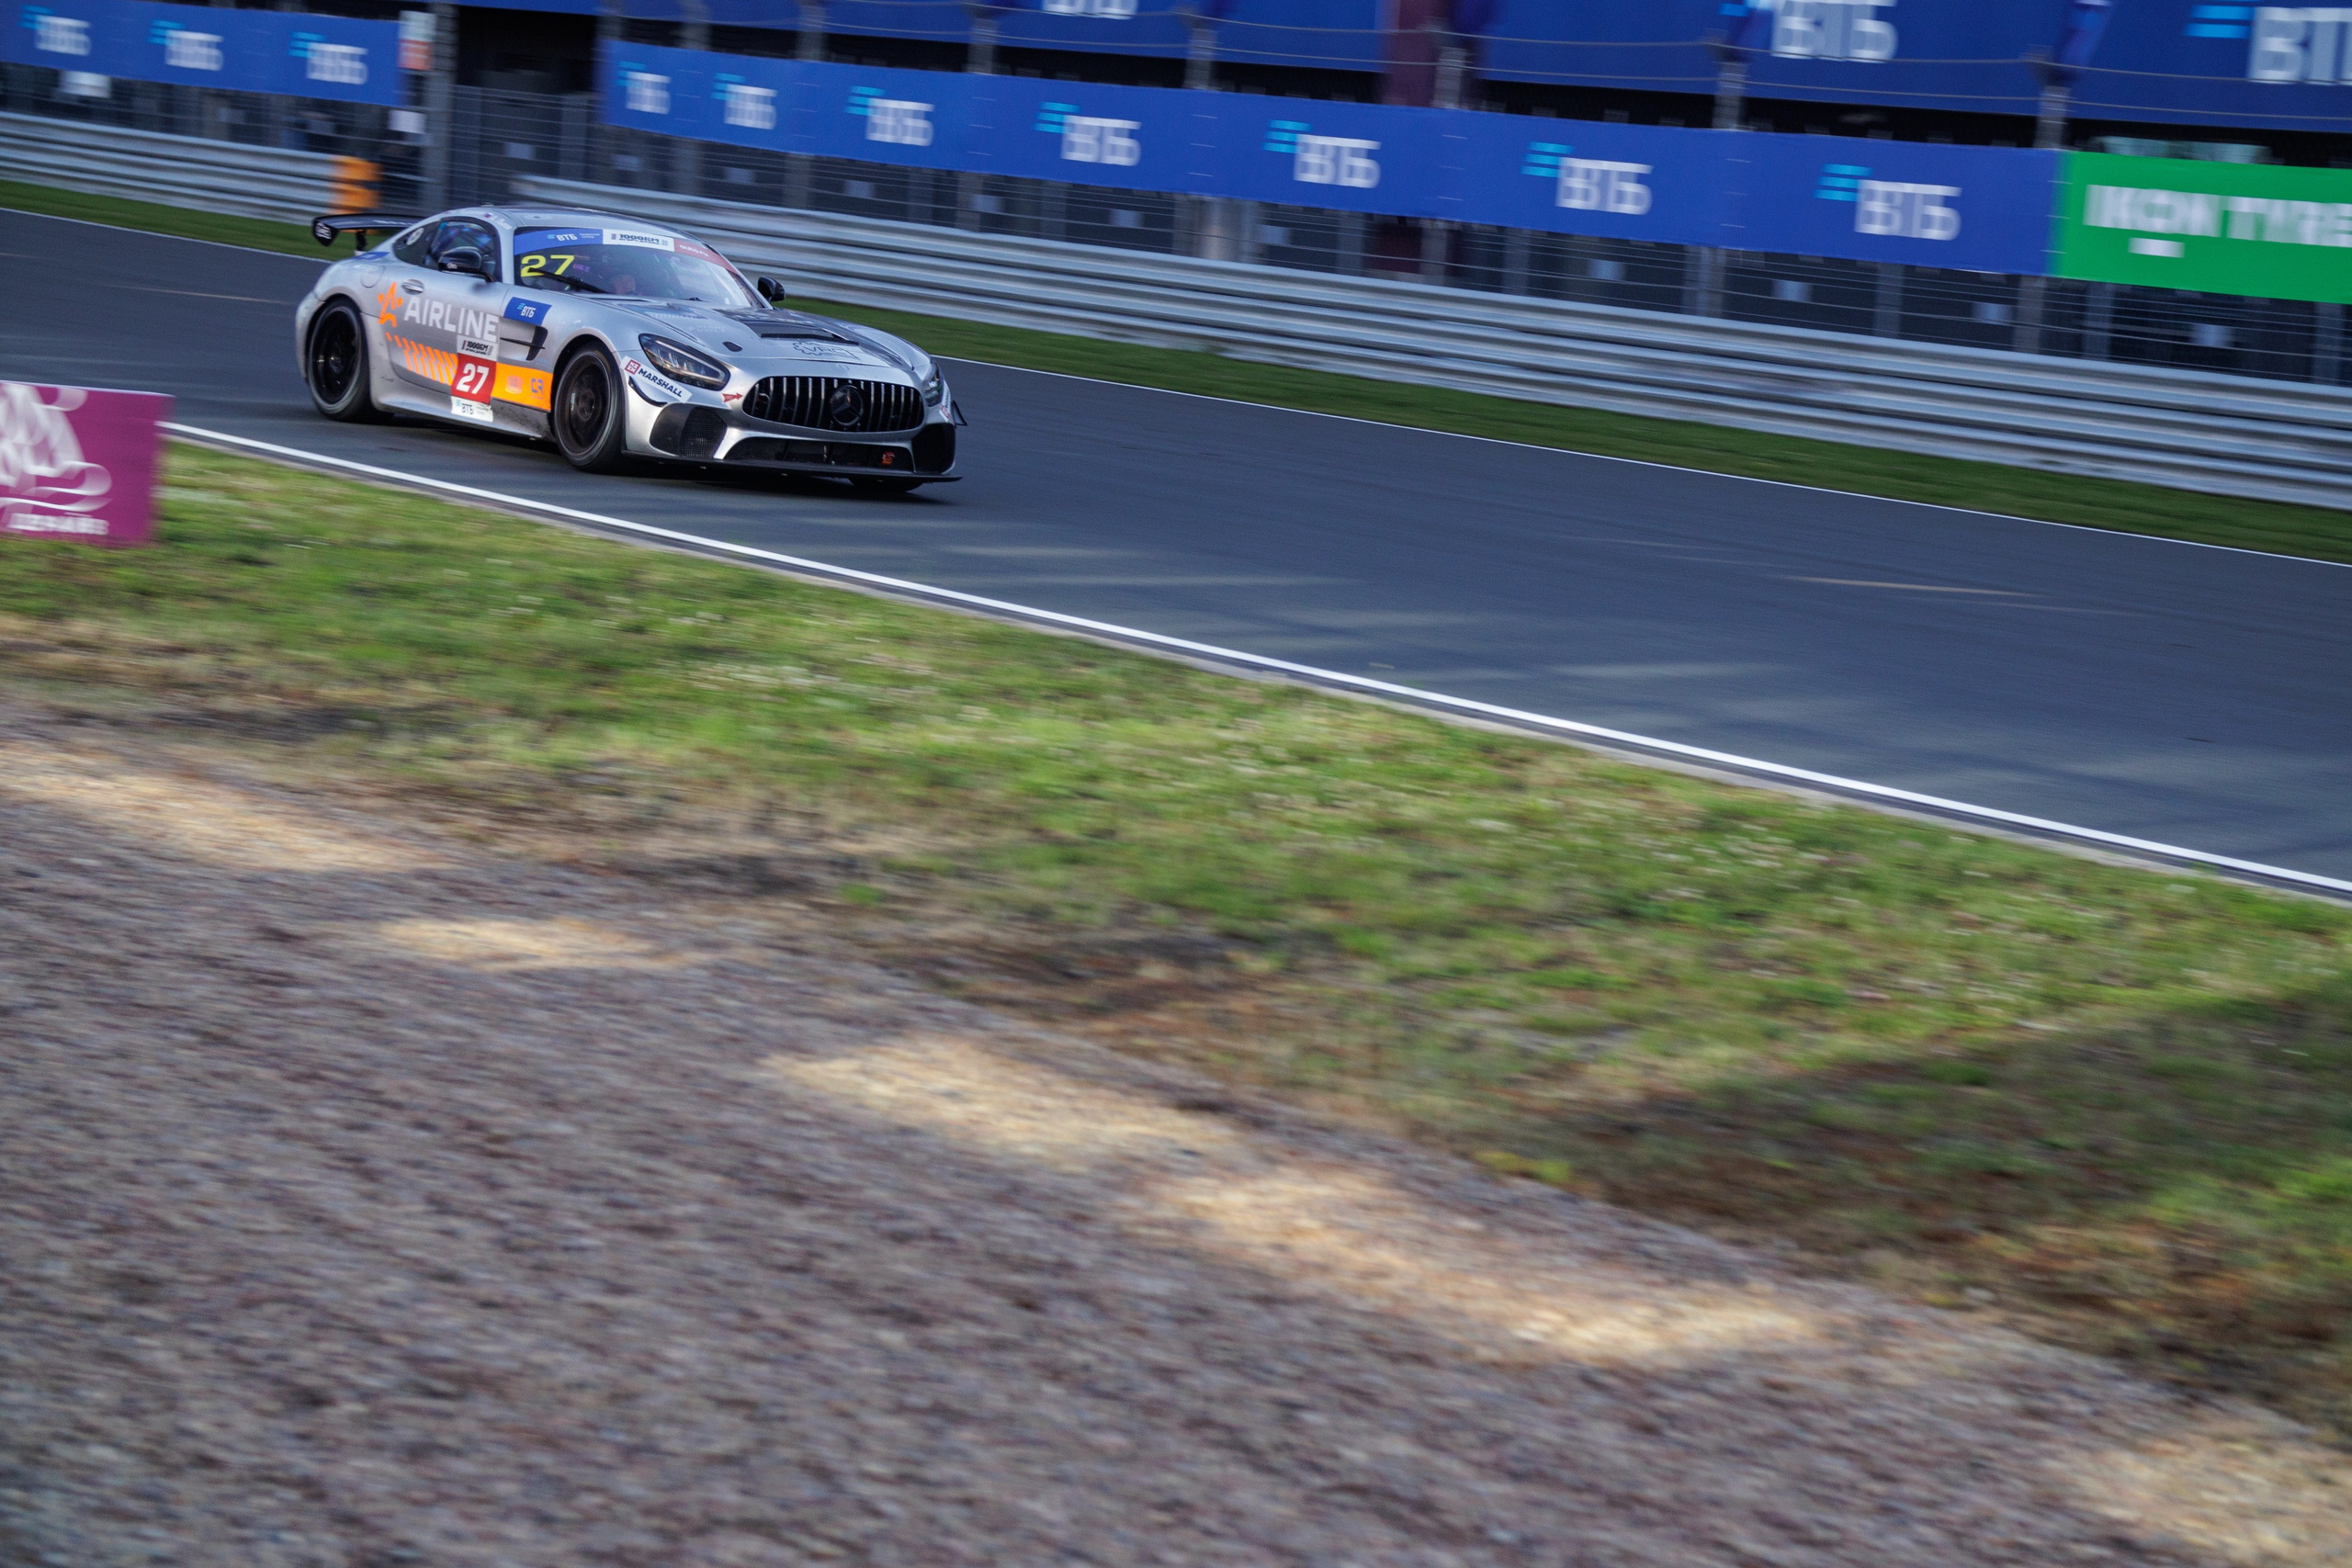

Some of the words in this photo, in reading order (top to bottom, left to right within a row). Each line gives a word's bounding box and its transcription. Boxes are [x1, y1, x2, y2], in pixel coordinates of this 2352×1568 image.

[556, 233, 578, 242] ВТБ
[520, 254, 575, 277] 27
[403, 296, 499, 343] AIRLINE
[520, 305, 537, 319] ВТБ
[456, 362, 490, 395] 27
[638, 367, 684, 398] MARSHALL
